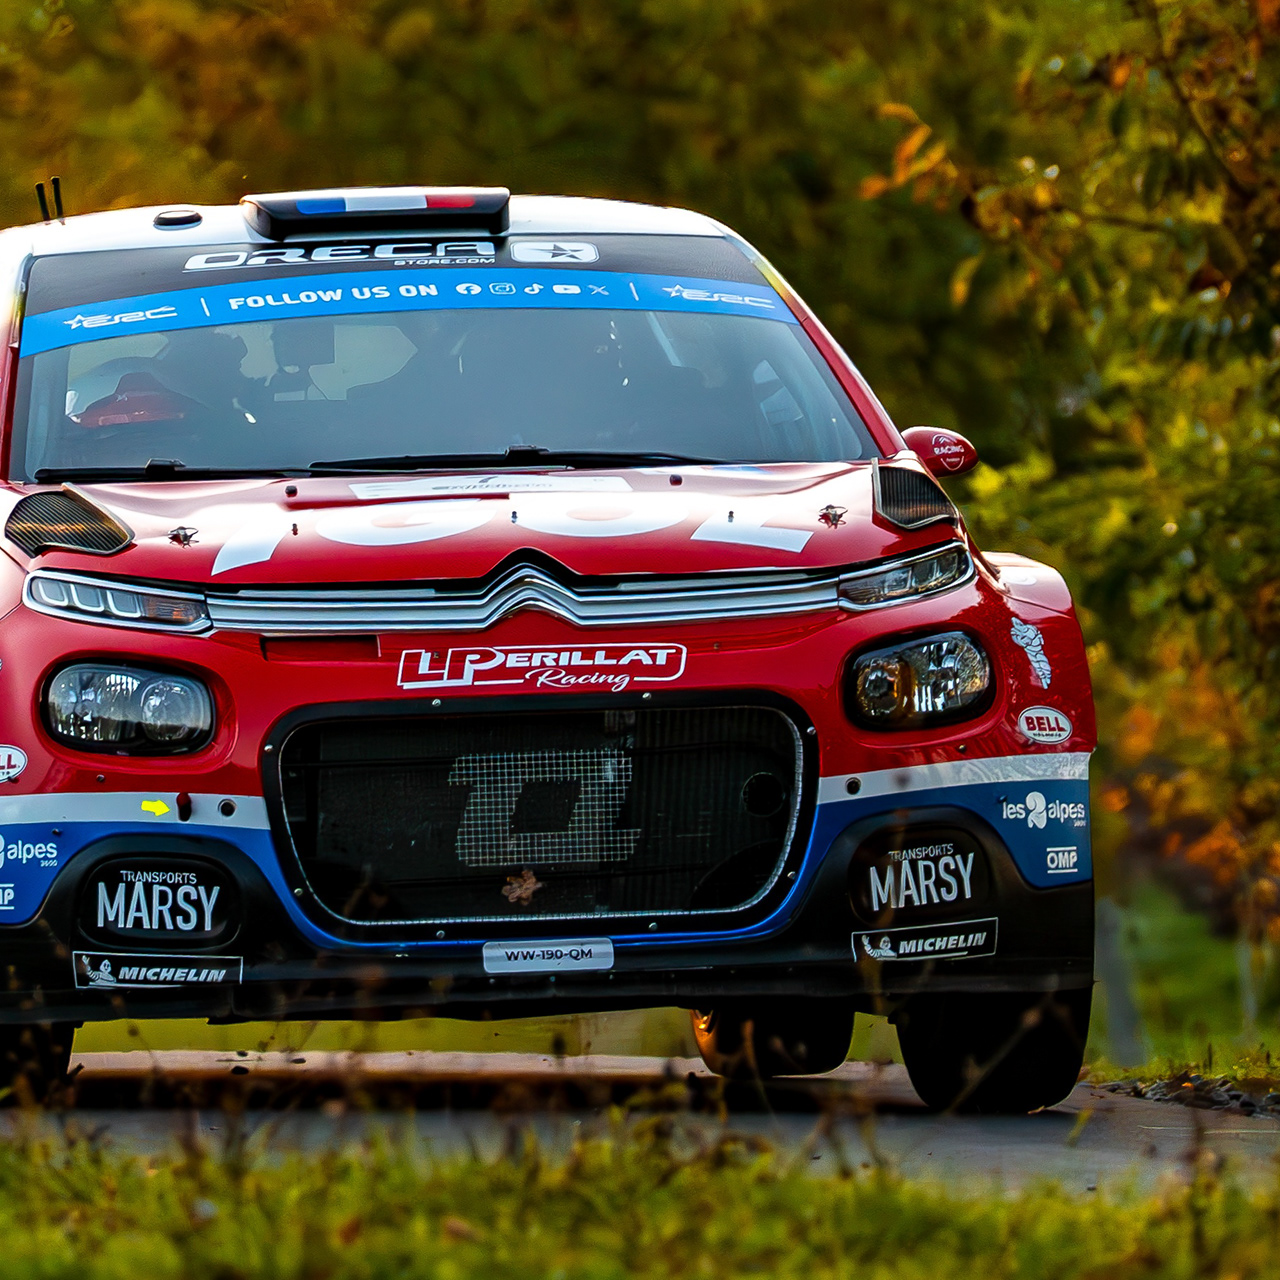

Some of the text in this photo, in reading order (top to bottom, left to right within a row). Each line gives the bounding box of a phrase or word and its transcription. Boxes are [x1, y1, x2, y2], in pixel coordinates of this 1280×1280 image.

[184, 241, 495, 270] ORECA
[393, 257, 495, 267] STORE.COM
[230, 283, 439, 310] FOLLOW US ON
[933, 444, 965, 455] RACING
[524, 667, 630, 691] Racing
[1025, 715, 1068, 732] BELL
[1002, 791, 1085, 829] les 2 alpes
[7, 839, 58, 864] alpes
[888, 843, 954, 862] TRANSPORTS
[1047, 851, 1078, 868] OMP
[120, 870, 197, 884] TRANSPORTS
[869, 852, 975, 912] MARSY
[97, 881, 221, 932] MARSY
[898, 931, 987, 954] MICHELIN
[505, 948, 593, 962] WW-190-QM
[118, 966, 227, 983] MICHELIN
